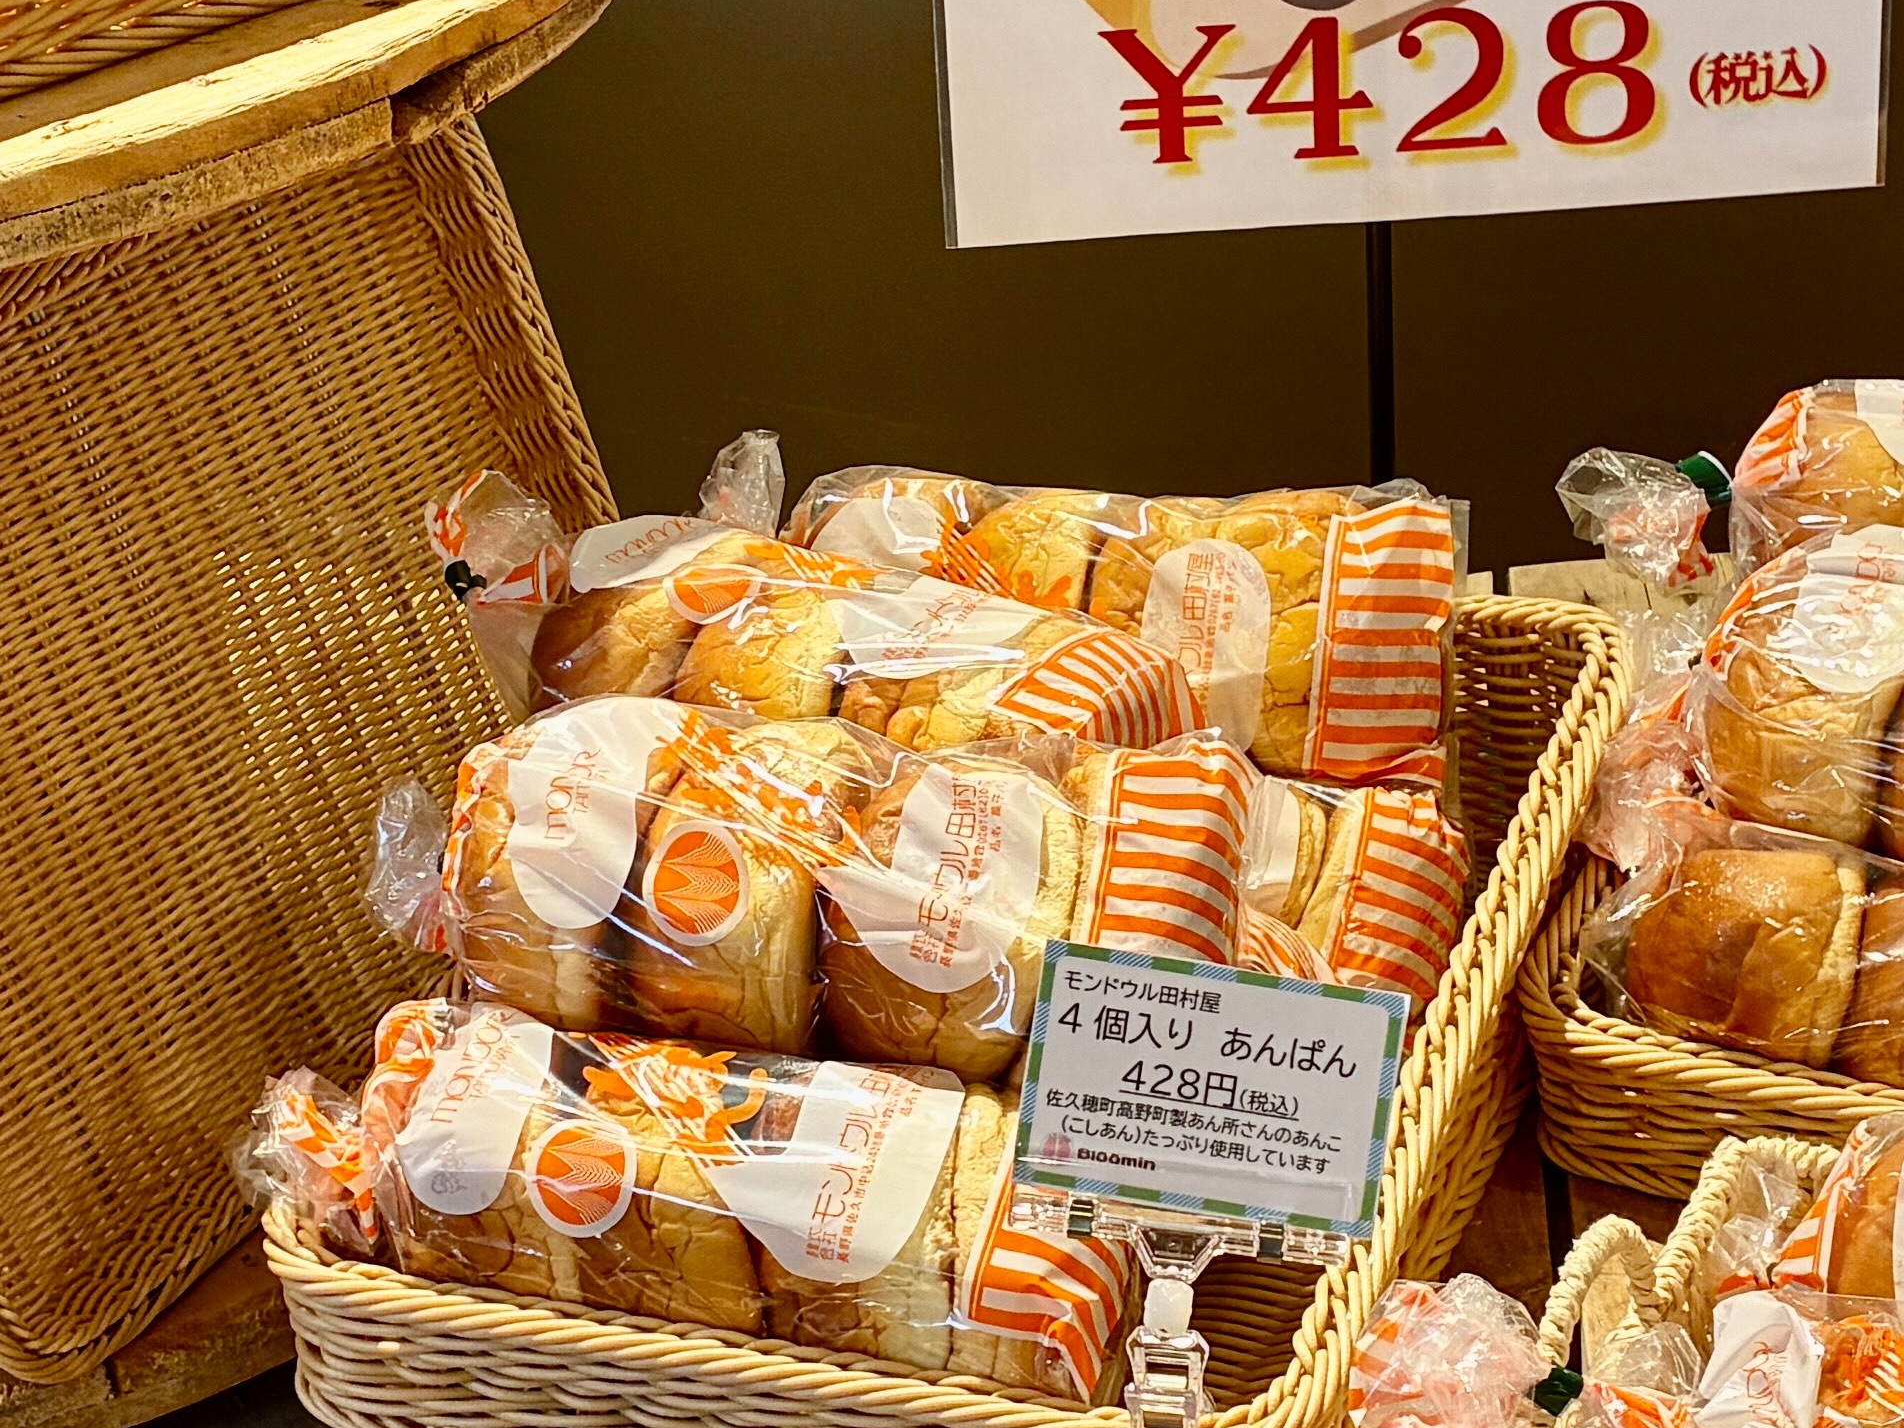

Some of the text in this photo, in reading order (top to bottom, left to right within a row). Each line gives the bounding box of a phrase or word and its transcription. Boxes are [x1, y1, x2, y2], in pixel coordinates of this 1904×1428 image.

[1688, 42, 1827, 107] (税込)
[1064, 969, 1223, 1015] モンドウル田村屋
[1057, 1001, 1357, 1080] 4個入り あんぱん
[1060, 1112, 1331, 1175] (こしあん)たっぷり使用しています
